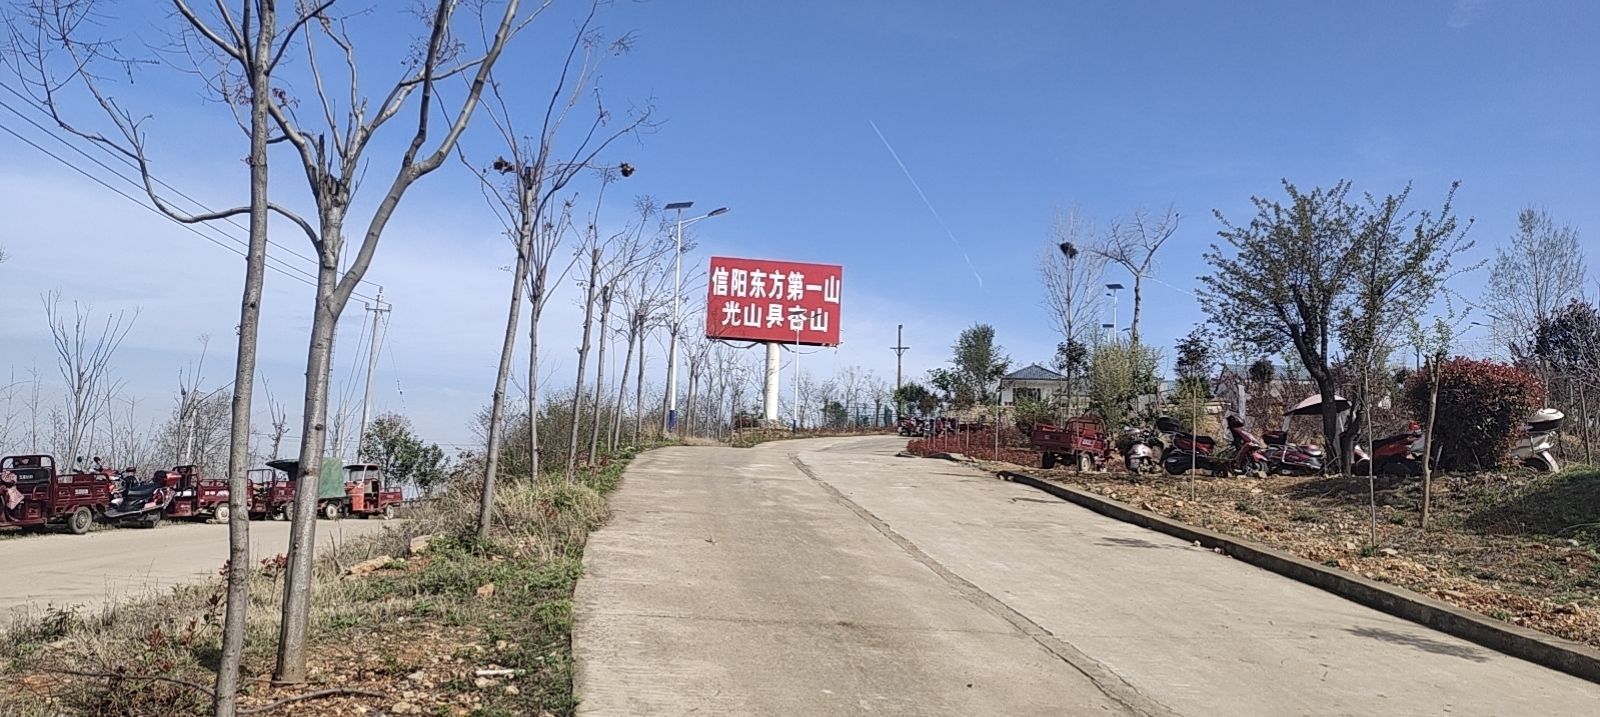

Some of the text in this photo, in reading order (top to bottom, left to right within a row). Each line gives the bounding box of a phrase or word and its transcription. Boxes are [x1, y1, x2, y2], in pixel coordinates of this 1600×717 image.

[712, 266, 840, 304] 信阳东方第一山
